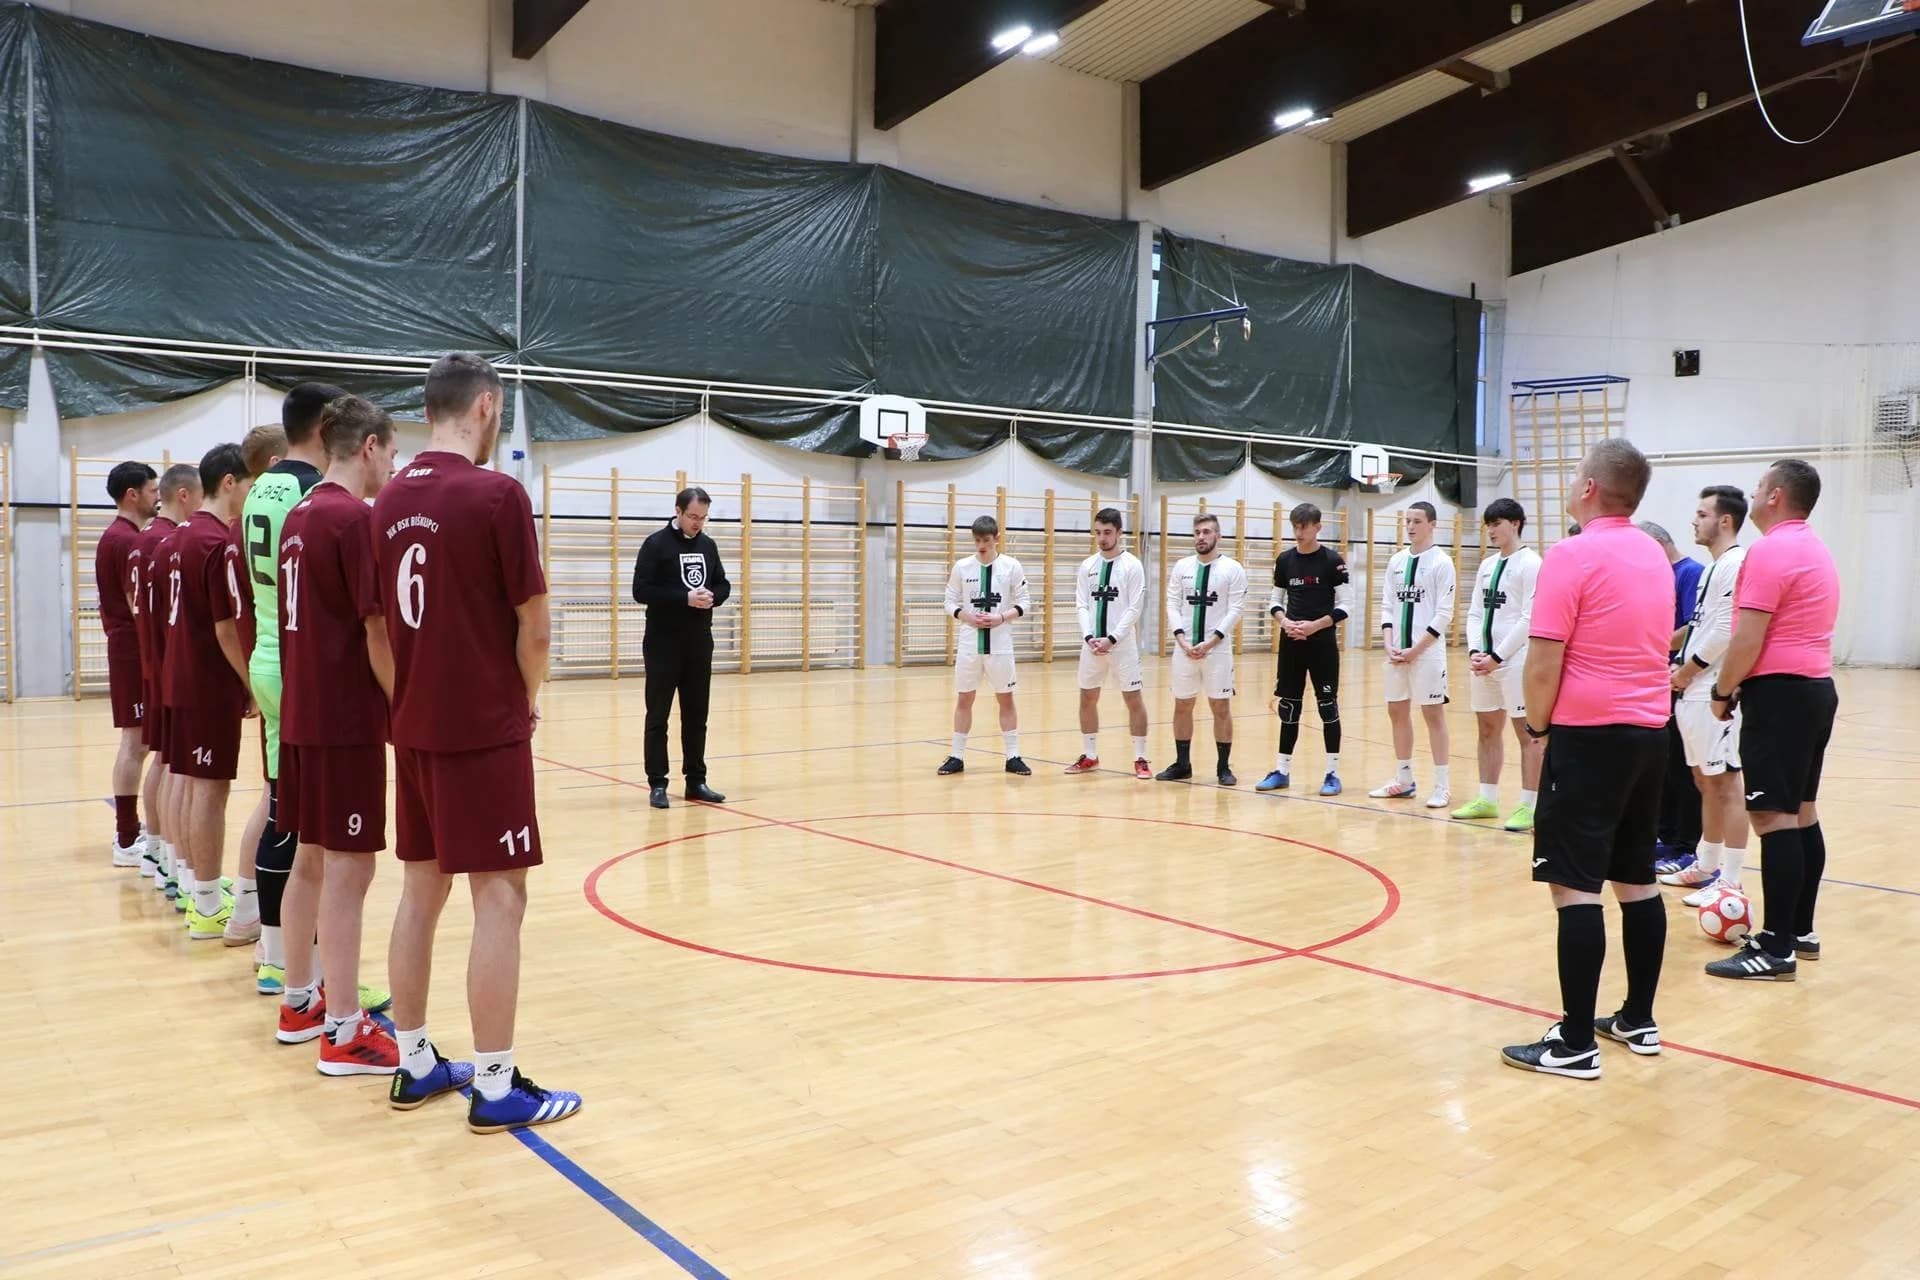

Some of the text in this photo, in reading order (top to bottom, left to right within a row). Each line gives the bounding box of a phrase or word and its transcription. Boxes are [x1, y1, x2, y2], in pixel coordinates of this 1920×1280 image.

[386, 524, 397, 539] NK
[397, 518, 410, 531] BSK
[397, 543, 426, 630] 6
[192, 746, 212, 766] 14
[347, 813, 362, 836] 9
[499, 825, 530, 856] 11
